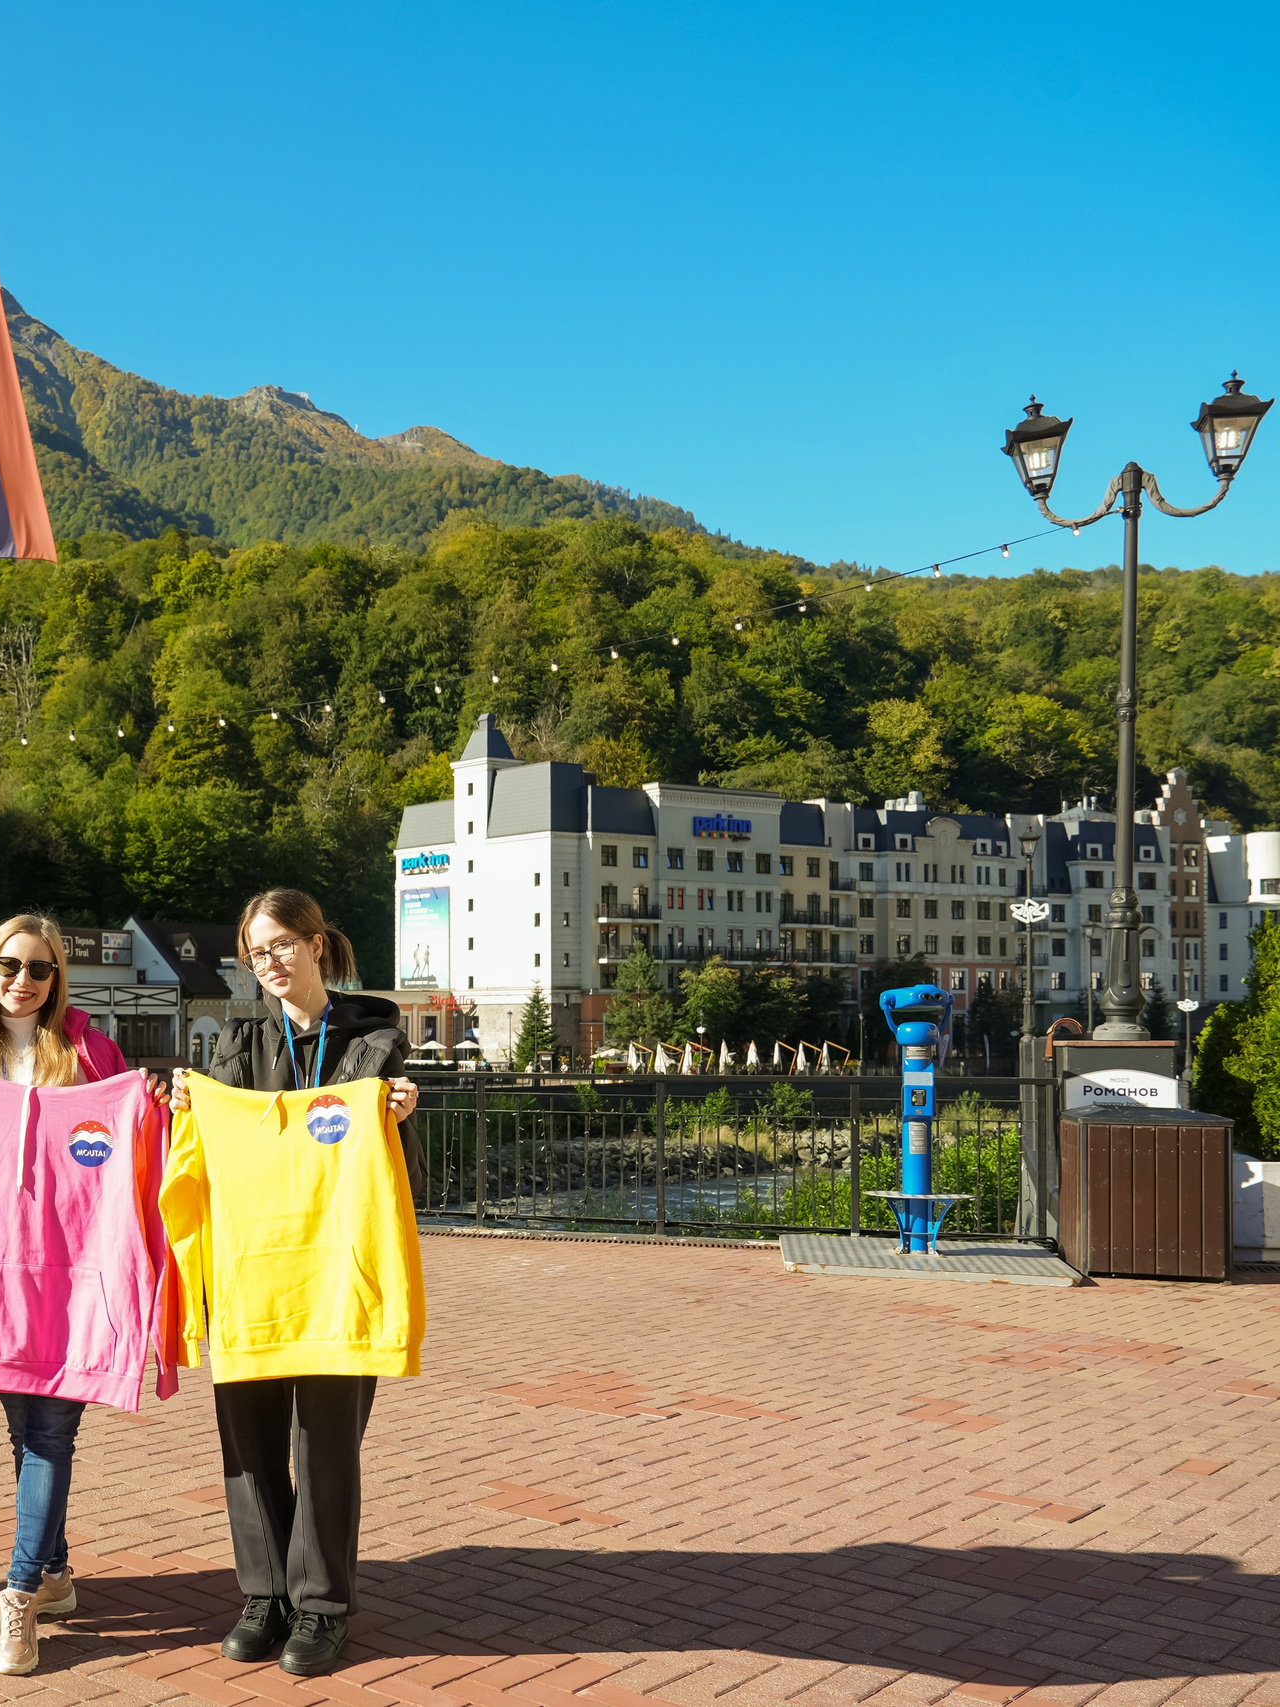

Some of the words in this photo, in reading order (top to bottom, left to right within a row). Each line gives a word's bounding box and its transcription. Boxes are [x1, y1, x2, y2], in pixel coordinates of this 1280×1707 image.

[693, 813, 728, 836] park
[727, 814, 752, 833] inn
[401, 852, 430, 874] park
[428, 851, 450, 866] inn
[75, 948, 89, 957] Tirol
[1083, 1085, 1158, 1097] Романов
[315, 1124, 345, 1135] MOUTAI
[76, 1149, 106, 1157] MOUTAI
